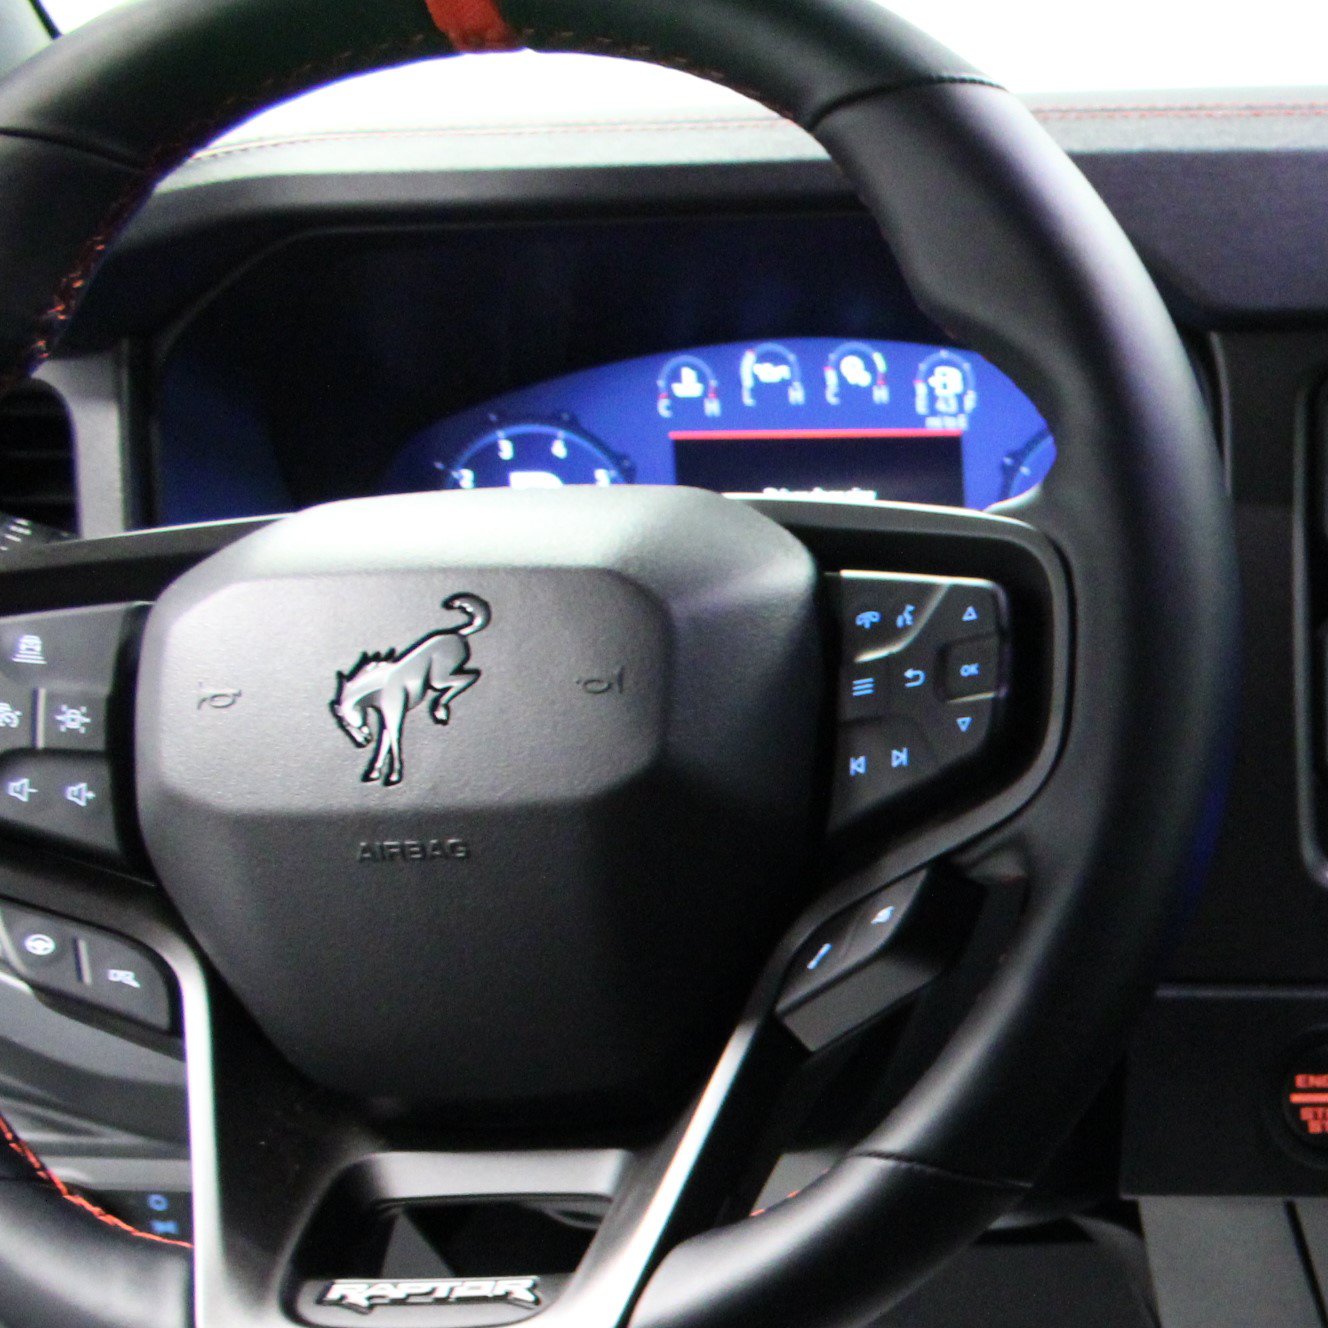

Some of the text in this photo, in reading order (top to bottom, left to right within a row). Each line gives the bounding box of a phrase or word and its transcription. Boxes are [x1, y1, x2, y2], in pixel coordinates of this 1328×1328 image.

[960, 663, 979, 677] OK
[357, 837, 470, 863] AIRBAG
[322, 1278, 541, 1311] RAPTOR
